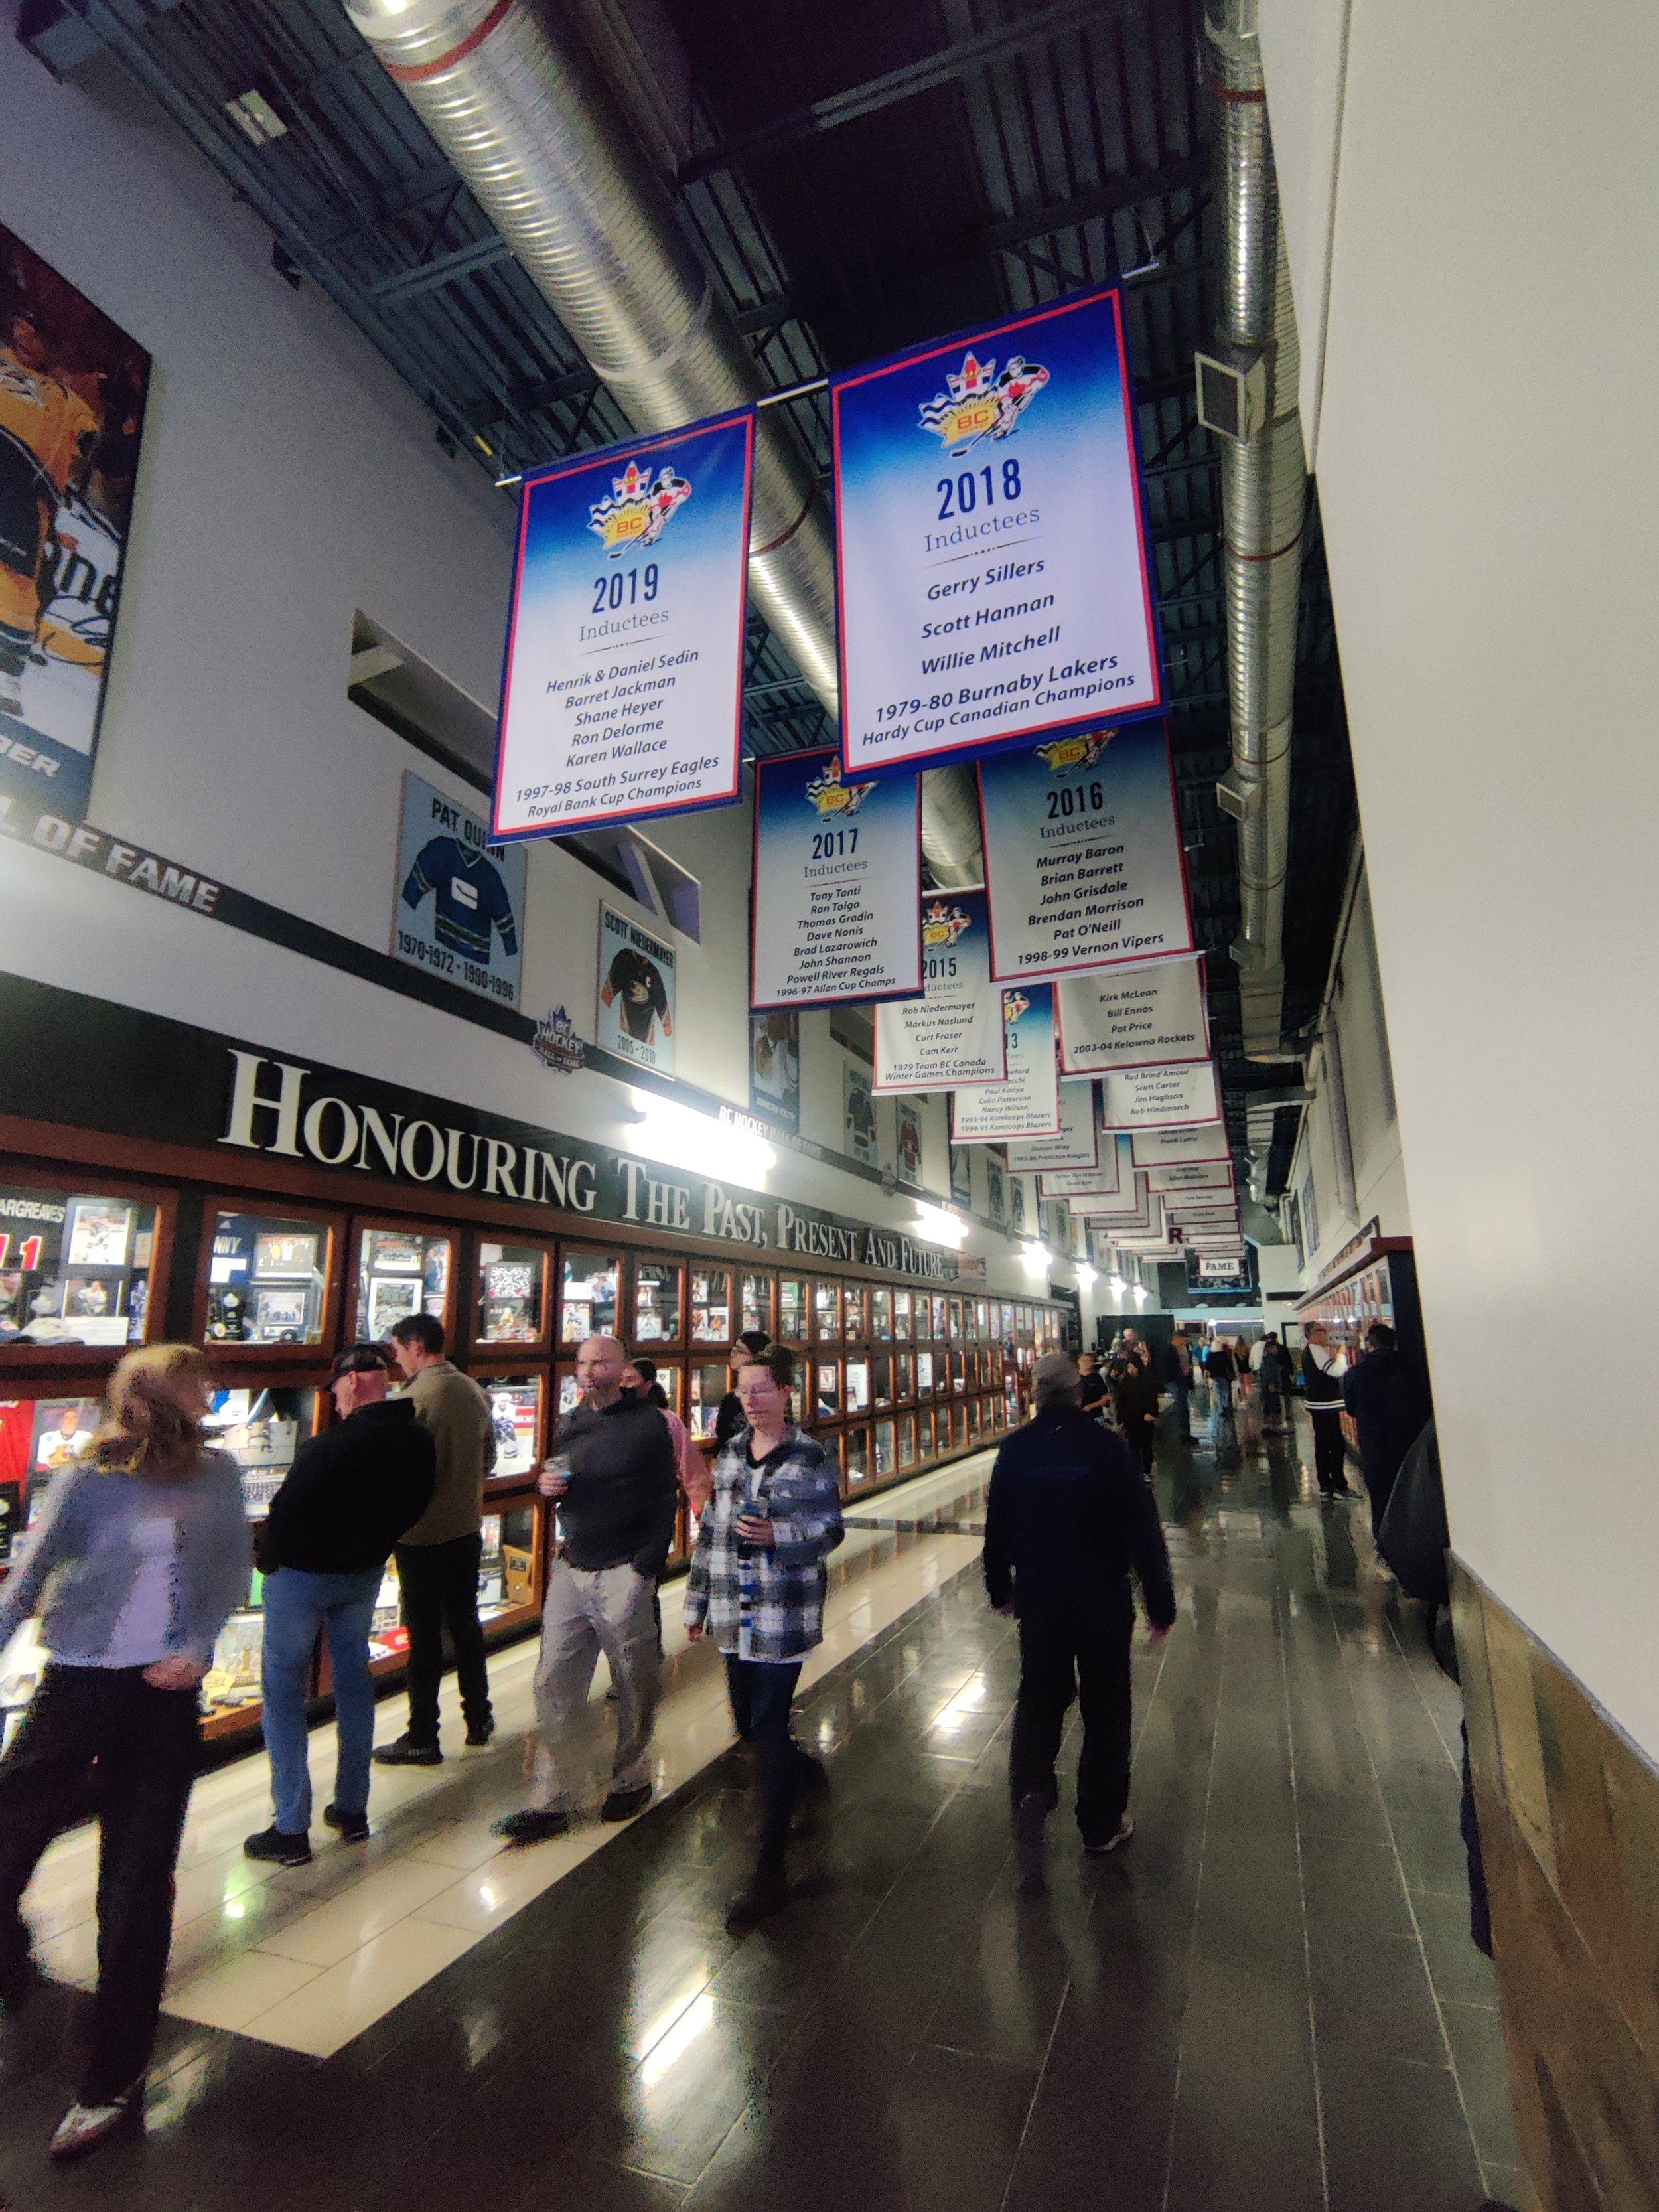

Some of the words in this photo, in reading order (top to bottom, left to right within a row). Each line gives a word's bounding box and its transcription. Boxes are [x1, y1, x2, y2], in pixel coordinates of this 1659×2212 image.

[958, 410, 989, 429] BC
[937, 459, 1021, 520] 2018
[617, 518, 642, 533] BC
[924, 508, 1040, 552] Inductees
[592, 564, 658, 614] 2019
[927, 575, 980, 600] Gerry
[985, 560, 1044, 585] Sillers
[579, 610, 669, 642] Inductees
[921, 615, 970, 638] Scott
[975, 594, 1054, 626] Hannan
[922, 651, 975, 674] Willie
[979, 625, 1060, 662] Mitchell
[546, 672, 591, 693] Henrik
[594, 669, 605, 682] &
[608, 656, 656, 680] Daniel
[658, 649, 699, 668] Sedin
[565, 689, 609, 709] Barret
[611, 676, 676, 699] Jackman
[876, 692, 953, 723] 1979-80
[958, 673, 1043, 704] Burnaby
[1048, 655, 1118, 682] Lakers
[574, 709, 618, 726] Shane
[621, 699, 664, 717] Heyer
[862, 724, 910, 746] Hardy
[914, 718, 945, 733] Cup
[949, 699, 1029, 725] Canadian
[1035, 675, 1135, 705] Champions
[571, 733, 599, 747] Ron
[602, 719, 664, 741] Delorme
[565, 751, 607, 767] Karen
[612, 739, 667, 759] Wallace
[1059, 747, 1080, 761] BC
[517, 781, 572, 802] 1997-98
[574, 773, 616, 792] South
[619, 767, 668, 784] Surrey
[670, 756, 719, 775] Eagles
[527, 800, 562, 818] Royal
[564, 795, 597, 811] Bank
[600, 793, 624, 806] Cup
[627, 779, 701, 800] Champions
[826, 794, 845, 804] BC
[1047, 782, 1103, 819] 2016
[432, 797, 460, 831] PAT
[1039, 815, 1115, 839] Inductees
[812, 828, 859, 859] 2017
[1036, 852, 1083, 869] Murray
[1085, 844, 1124, 859] Baron
[33, 814, 102, 859] OF
[106, 844, 220, 913] FAME
[804, 860, 867, 878] Inductees
[1041, 872, 1074, 887] Brian
[1077, 862, 1123, 879] Barrett
[810, 892, 833, 901] Tony
[835, 885, 861, 897] Tanti
[1040, 891, 1070, 905] John
[1073, 880, 1127, 899] Grisdale
[798, 917, 836, 929] Thomas
[839, 911, 873, 924] Gradin
[810, 905, 830, 915] Ron
[832, 901, 859, 912] Toigo
[1028, 909, 1082, 926] Brendan
[1085, 897, 1144, 917] Morrison
[605, 911, 628, 939] SCOTT
[630, 927, 674, 968] NIEDERMAYER
[806, 932, 832, 942] Dave
[834, 926, 863, 938] Nonis
[1054, 928, 1075, 940] Pat
[1078, 918, 1121, 936] O'Neill
[793, 944, 818, 956] Brad
[818, 936, 877, 954] Lazarowich
[1018, 947, 1069, 965] 1998-99
[1072, 942, 1118, 956] Vernon
[1121, 934, 1163, 949] Vipers
[399, 930, 454, 974] 1970-1972
[465, 962, 514, 1001] 1990-1996
[786, 971, 820, 984] Powell
[822, 970, 848, 980] River
[849, 964, 884, 978] Regals
[798, 958, 823, 970] John
[825, 954, 871, 966] Shannon
[923, 957, 956, 979] 2015
[776, 986, 812, 997] 1996-97
[814, 984, 837, 993] Allan
[839, 982, 857, 991] Cup
[859, 978, 895, 988] Champs
[1100, 993, 1119, 1003] Kirk
[1121, 989, 1157, 999] McLean
[920, 1003, 975, 1013] Niedermayer
[1107, 1008, 1123, 1018] Bill
[904, 1019, 936, 1028] Markus
[938, 1015, 974, 1025] Naslund
[1111, 1025, 1127, 1033] Pat
[1129, 1021, 1152, 1031] Price
[541, 1027, 581, 1055] HOCKEY
[618, 1035, 634, 1054] 2005
[641, 1046, 656, 1065] 2010
[1073, 1042, 1112, 1054] 2003-04
[1114, 1038, 1155, 1049] Kelowna
[1157, 1033, 1195, 1044] Rockets
[939, 1060, 952, 1069] BC
[953, 1057, 986, 1067] Canada
[946, 1067, 995, 1077] Champions
[719, 1105, 733, 1124] BC
[733, 1111, 769, 1136] HOCKEY
[1147, 1104, 1189, 1113] Hindmarch
[216, 1049, 597, 1211] HONOURING
[617, 1157, 690, 1229] THE
[702, 1181, 768, 1249] PAST,
[776, 1203, 857, 1262] PRESENT
[865, 1230, 896, 1269] AND
[900, 1236, 944, 1278] FUTURE
